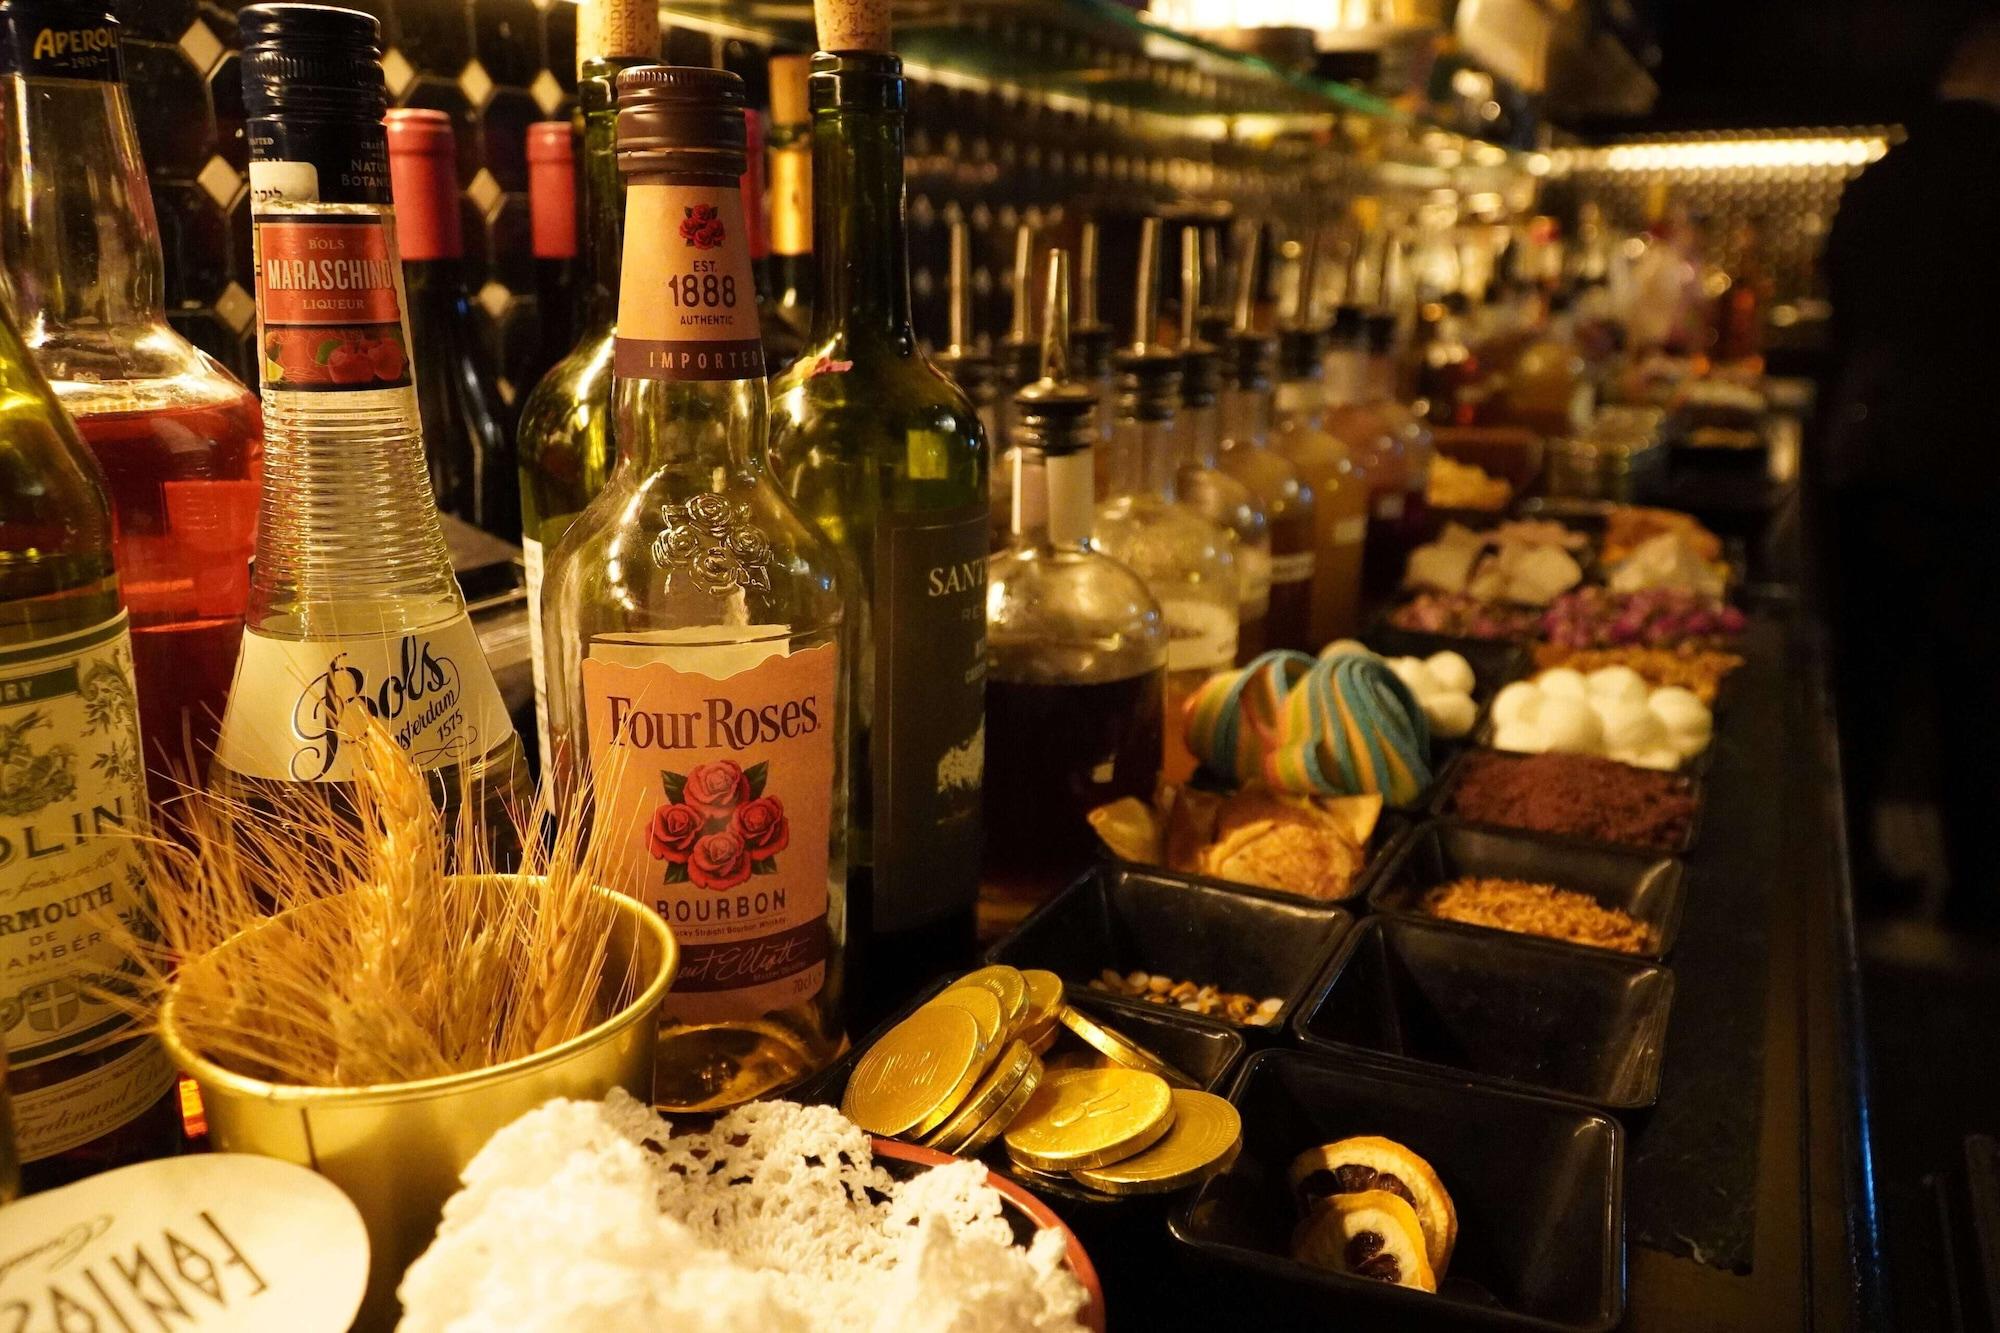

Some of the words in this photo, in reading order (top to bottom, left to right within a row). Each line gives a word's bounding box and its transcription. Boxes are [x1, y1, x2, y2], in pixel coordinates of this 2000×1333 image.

[33, 26, 118, 59] APEROL
[308, 239, 345, 250] BOLS
[267, 259, 393, 290] MARASCHINO
[303, 299, 365, 310] LIQUEUR
[668, 274, 736, 308] 1888
[680, 315, 734, 325] AUTHENTIC
[650, 351, 758, 369] IMPORTED
[0, 681, 33, 704] RY
[437, 709, 464, 742] 1575
[607, 696, 702, 750] Four
[703, 696, 818, 751] Roses
[656, 888, 786, 922] BOURBON
[29, 931, 58, 947] DE
